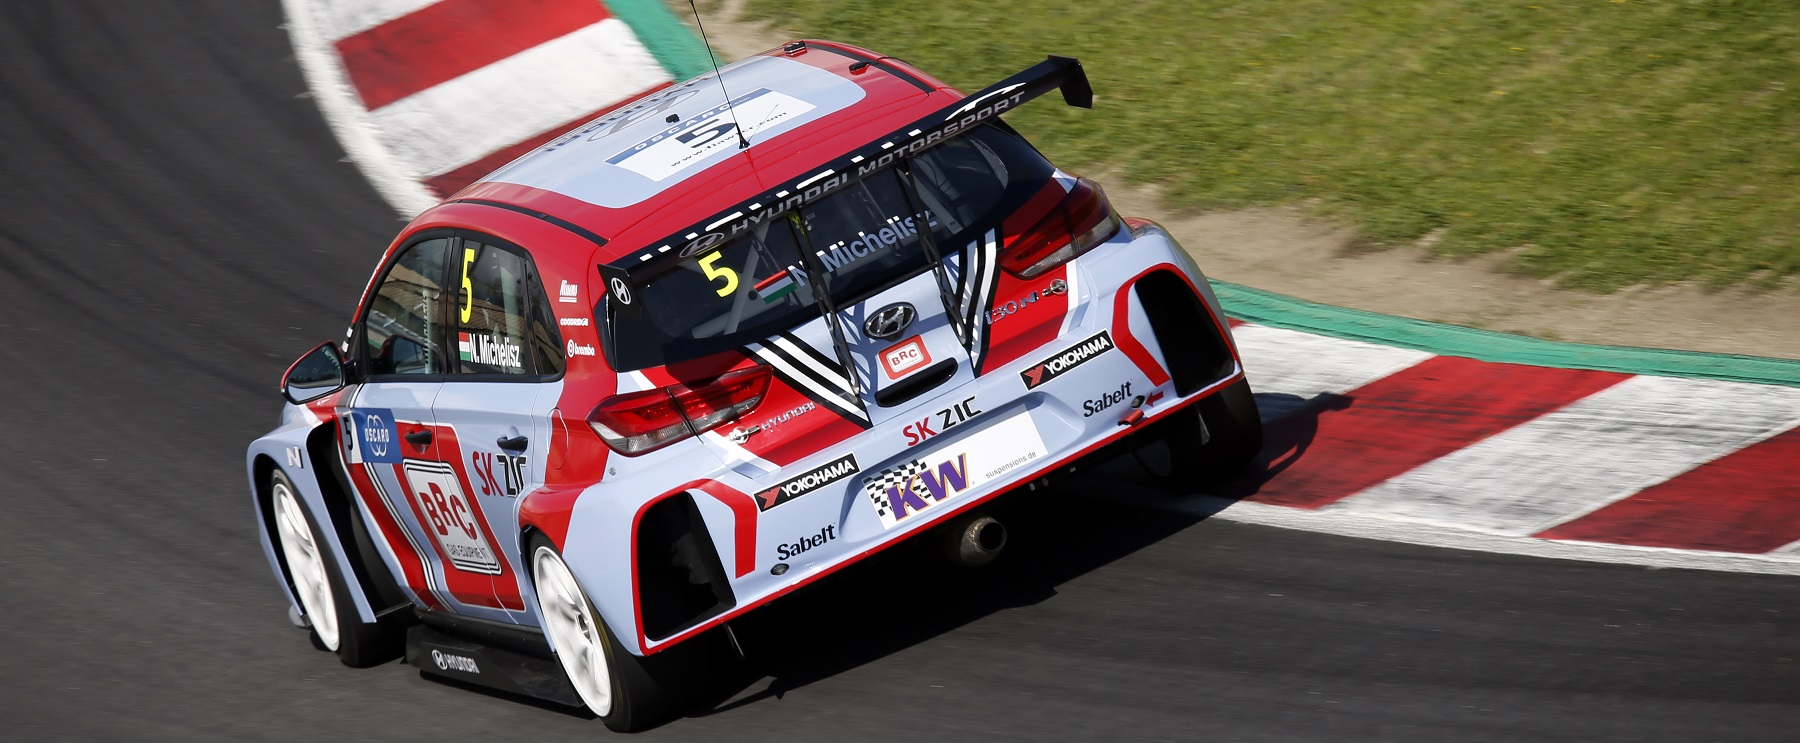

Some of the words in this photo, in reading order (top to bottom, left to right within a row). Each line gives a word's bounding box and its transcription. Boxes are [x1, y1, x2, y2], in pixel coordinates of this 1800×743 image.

[674, 118, 737, 149] 5
[731, 172, 848, 236] HYUNDAI
[858, 90, 1025, 177] MOTORSPORT
[816, 210, 938, 273] Michelisz
[460, 248, 475, 324] 5
[698, 251, 739, 298] 5
[469, 333, 480, 363] N.
[479, 334, 521, 368] Michelisz
[574, 343, 595, 356] brembo
[891, 349, 918, 366] BRC
[1045, 335, 1110, 375] YOKOHAMA
[760, 402, 816, 433] HYUNDAI
[1083, 381, 1133, 418] Sabelt
[365, 427, 390, 443] OSCARO
[902, 416, 937, 446] SK
[936, 395, 982, 430] ZIC
[472, 451, 504, 497] SK
[495, 454, 527, 498] ZIC
[780, 458, 855, 498] YOKOHAMA
[985, 450, 1037, 479] suspensions.de
[884, 452, 970, 522] KW
[418, 481, 477, 540] BRC
[777, 524, 835, 561] Sabelt
[444, 653, 480, 674] HYUNDAI
